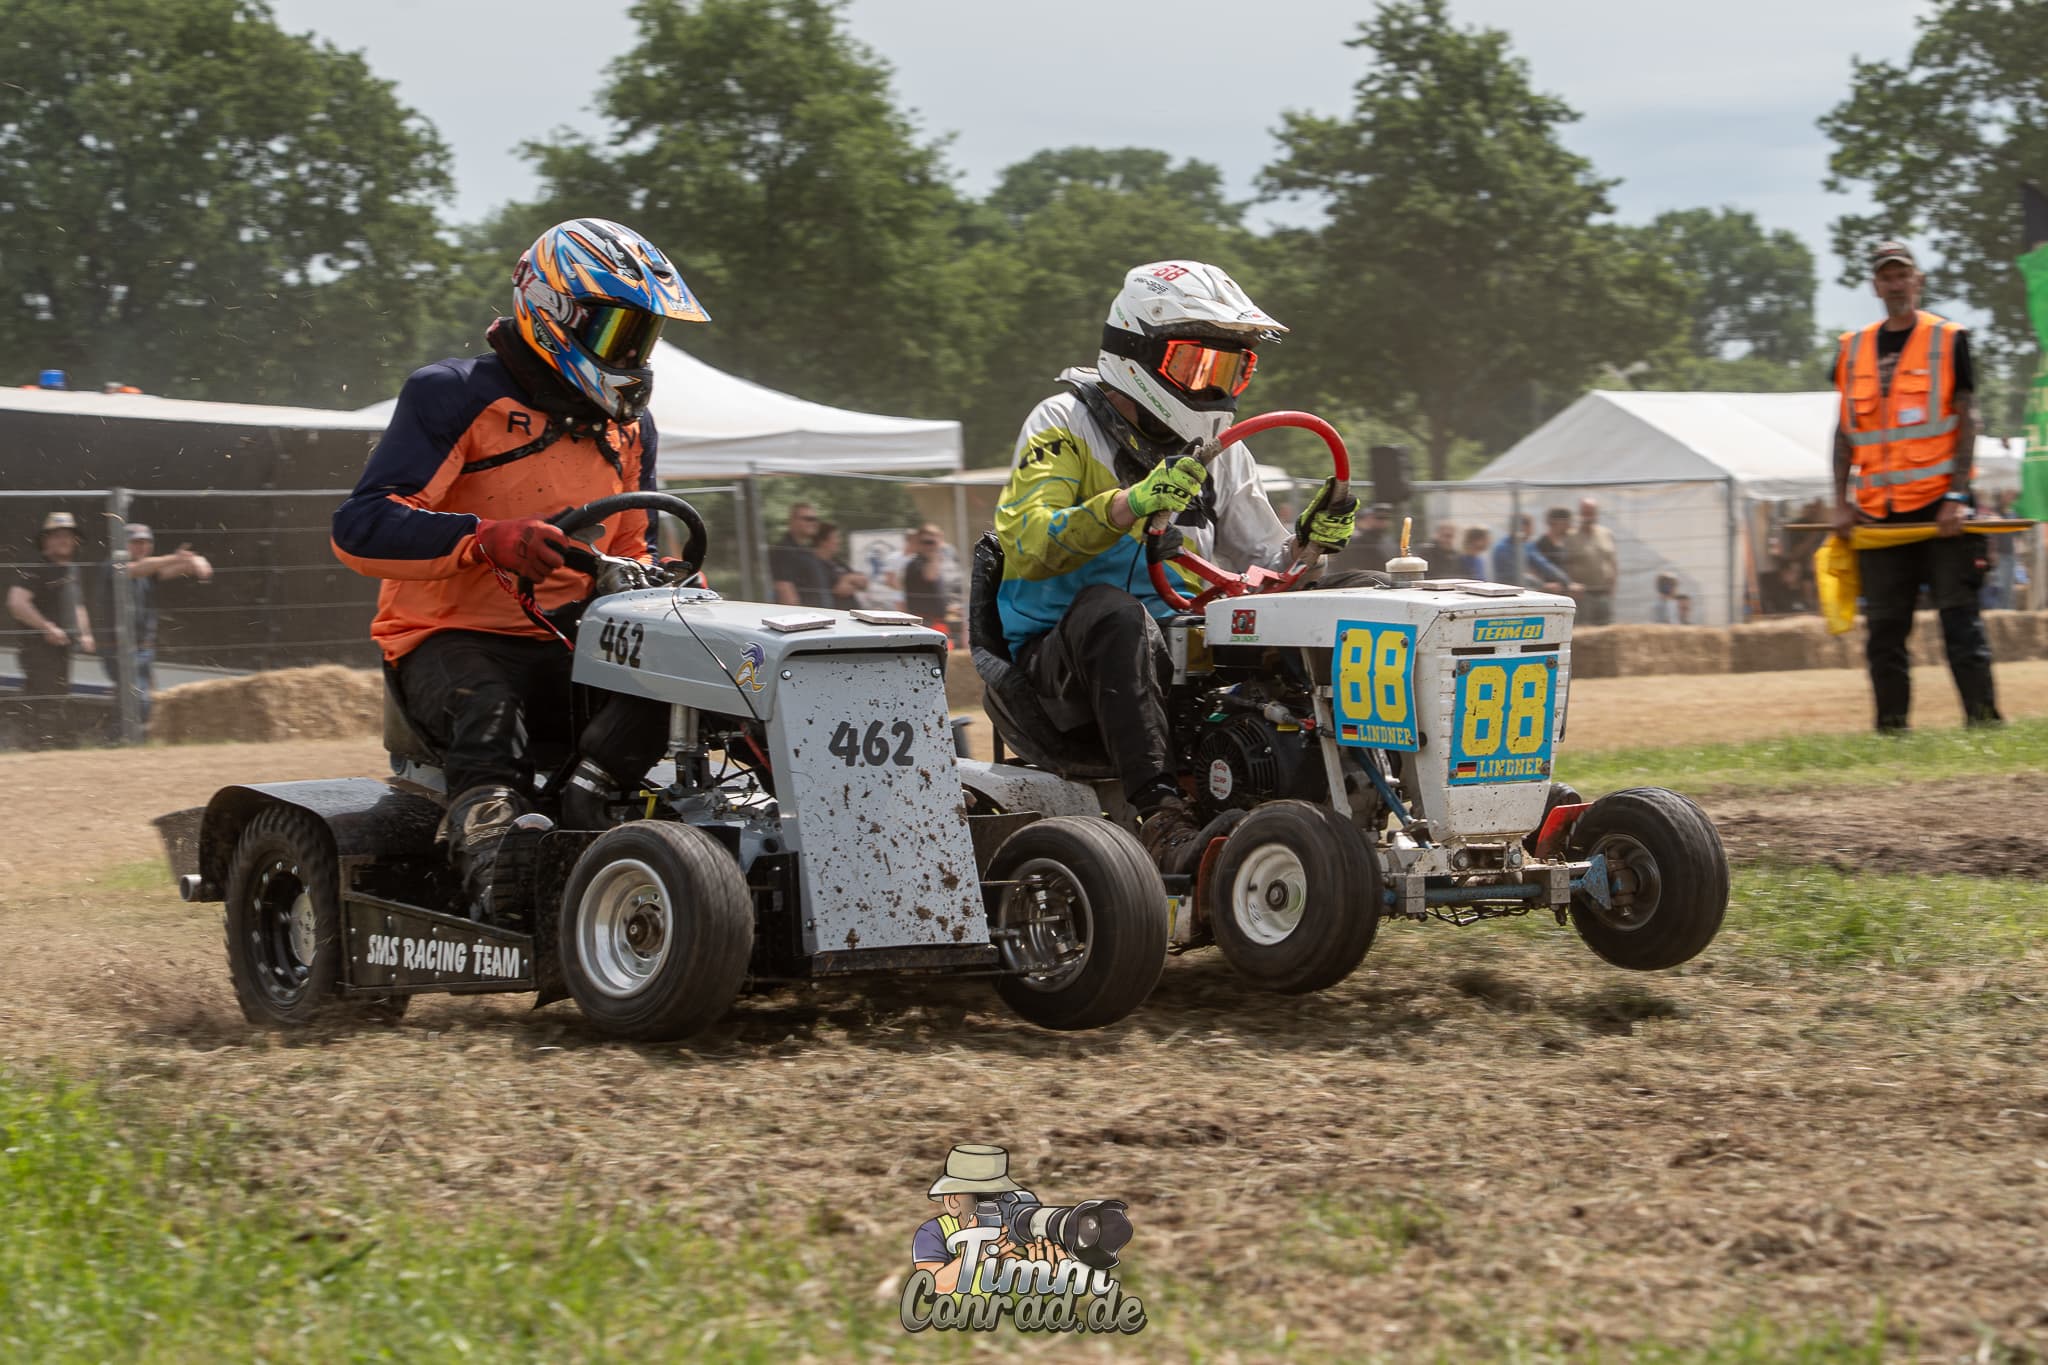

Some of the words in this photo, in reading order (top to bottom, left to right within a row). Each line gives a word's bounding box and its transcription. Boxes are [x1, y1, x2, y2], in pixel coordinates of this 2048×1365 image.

[599, 617, 645, 669] 462
[1475, 625, 1523, 641] TEAM
[1339, 627, 1408, 723] 88
[1461, 663, 1549, 757] 88
[828, 719, 914, 767] 462
[1359, 723, 1413, 746] LINDNER
[1478, 757, 1545, 777] LINDNER
[366, 934, 400, 966] SMS
[402, 937, 468, 974] RACING
[472, 943, 520, 979] TEAM
